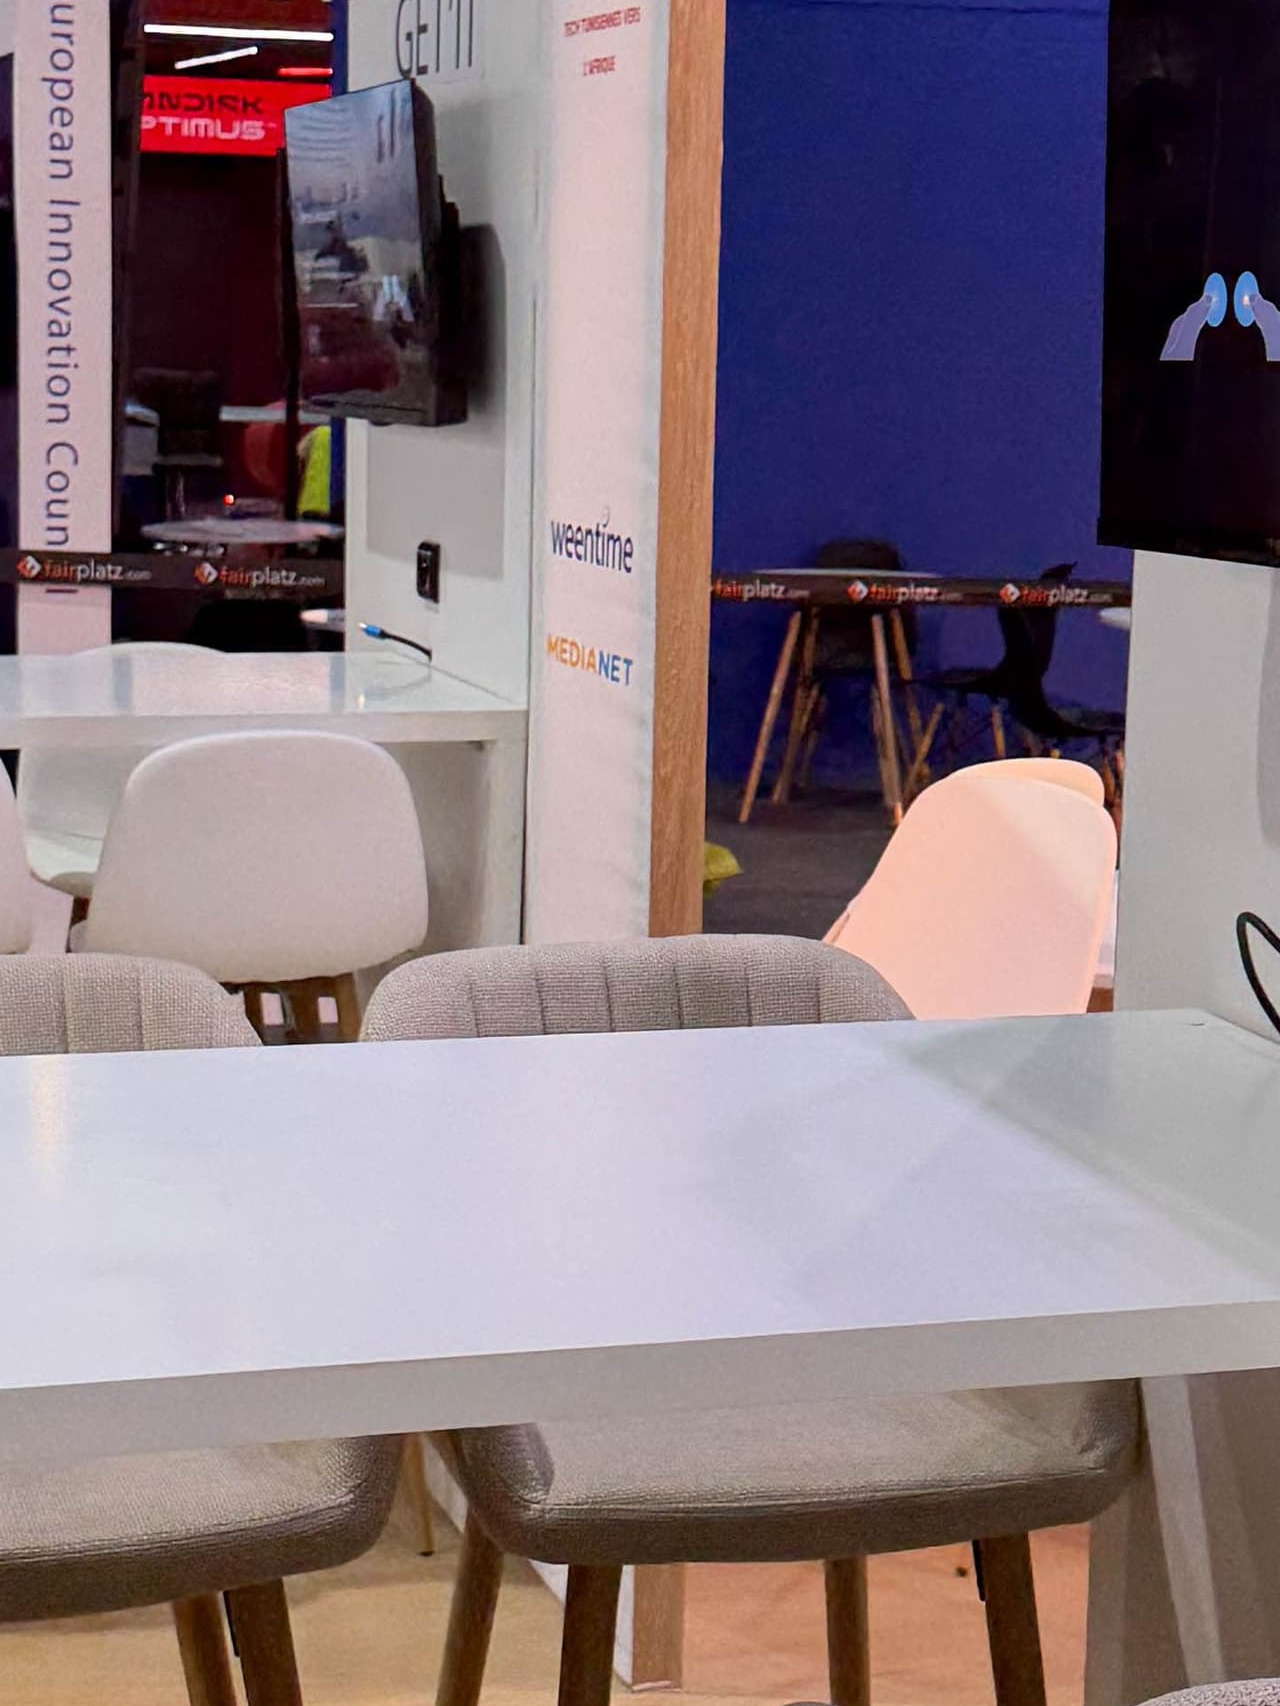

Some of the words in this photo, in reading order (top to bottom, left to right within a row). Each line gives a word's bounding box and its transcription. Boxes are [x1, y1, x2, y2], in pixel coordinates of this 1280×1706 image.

[45, 198, 81, 426] Innovation
[45, 439, 80, 593] Counl
[551, 507, 634, 574] weentime
[546, 632, 634, 687] MEDIANET
